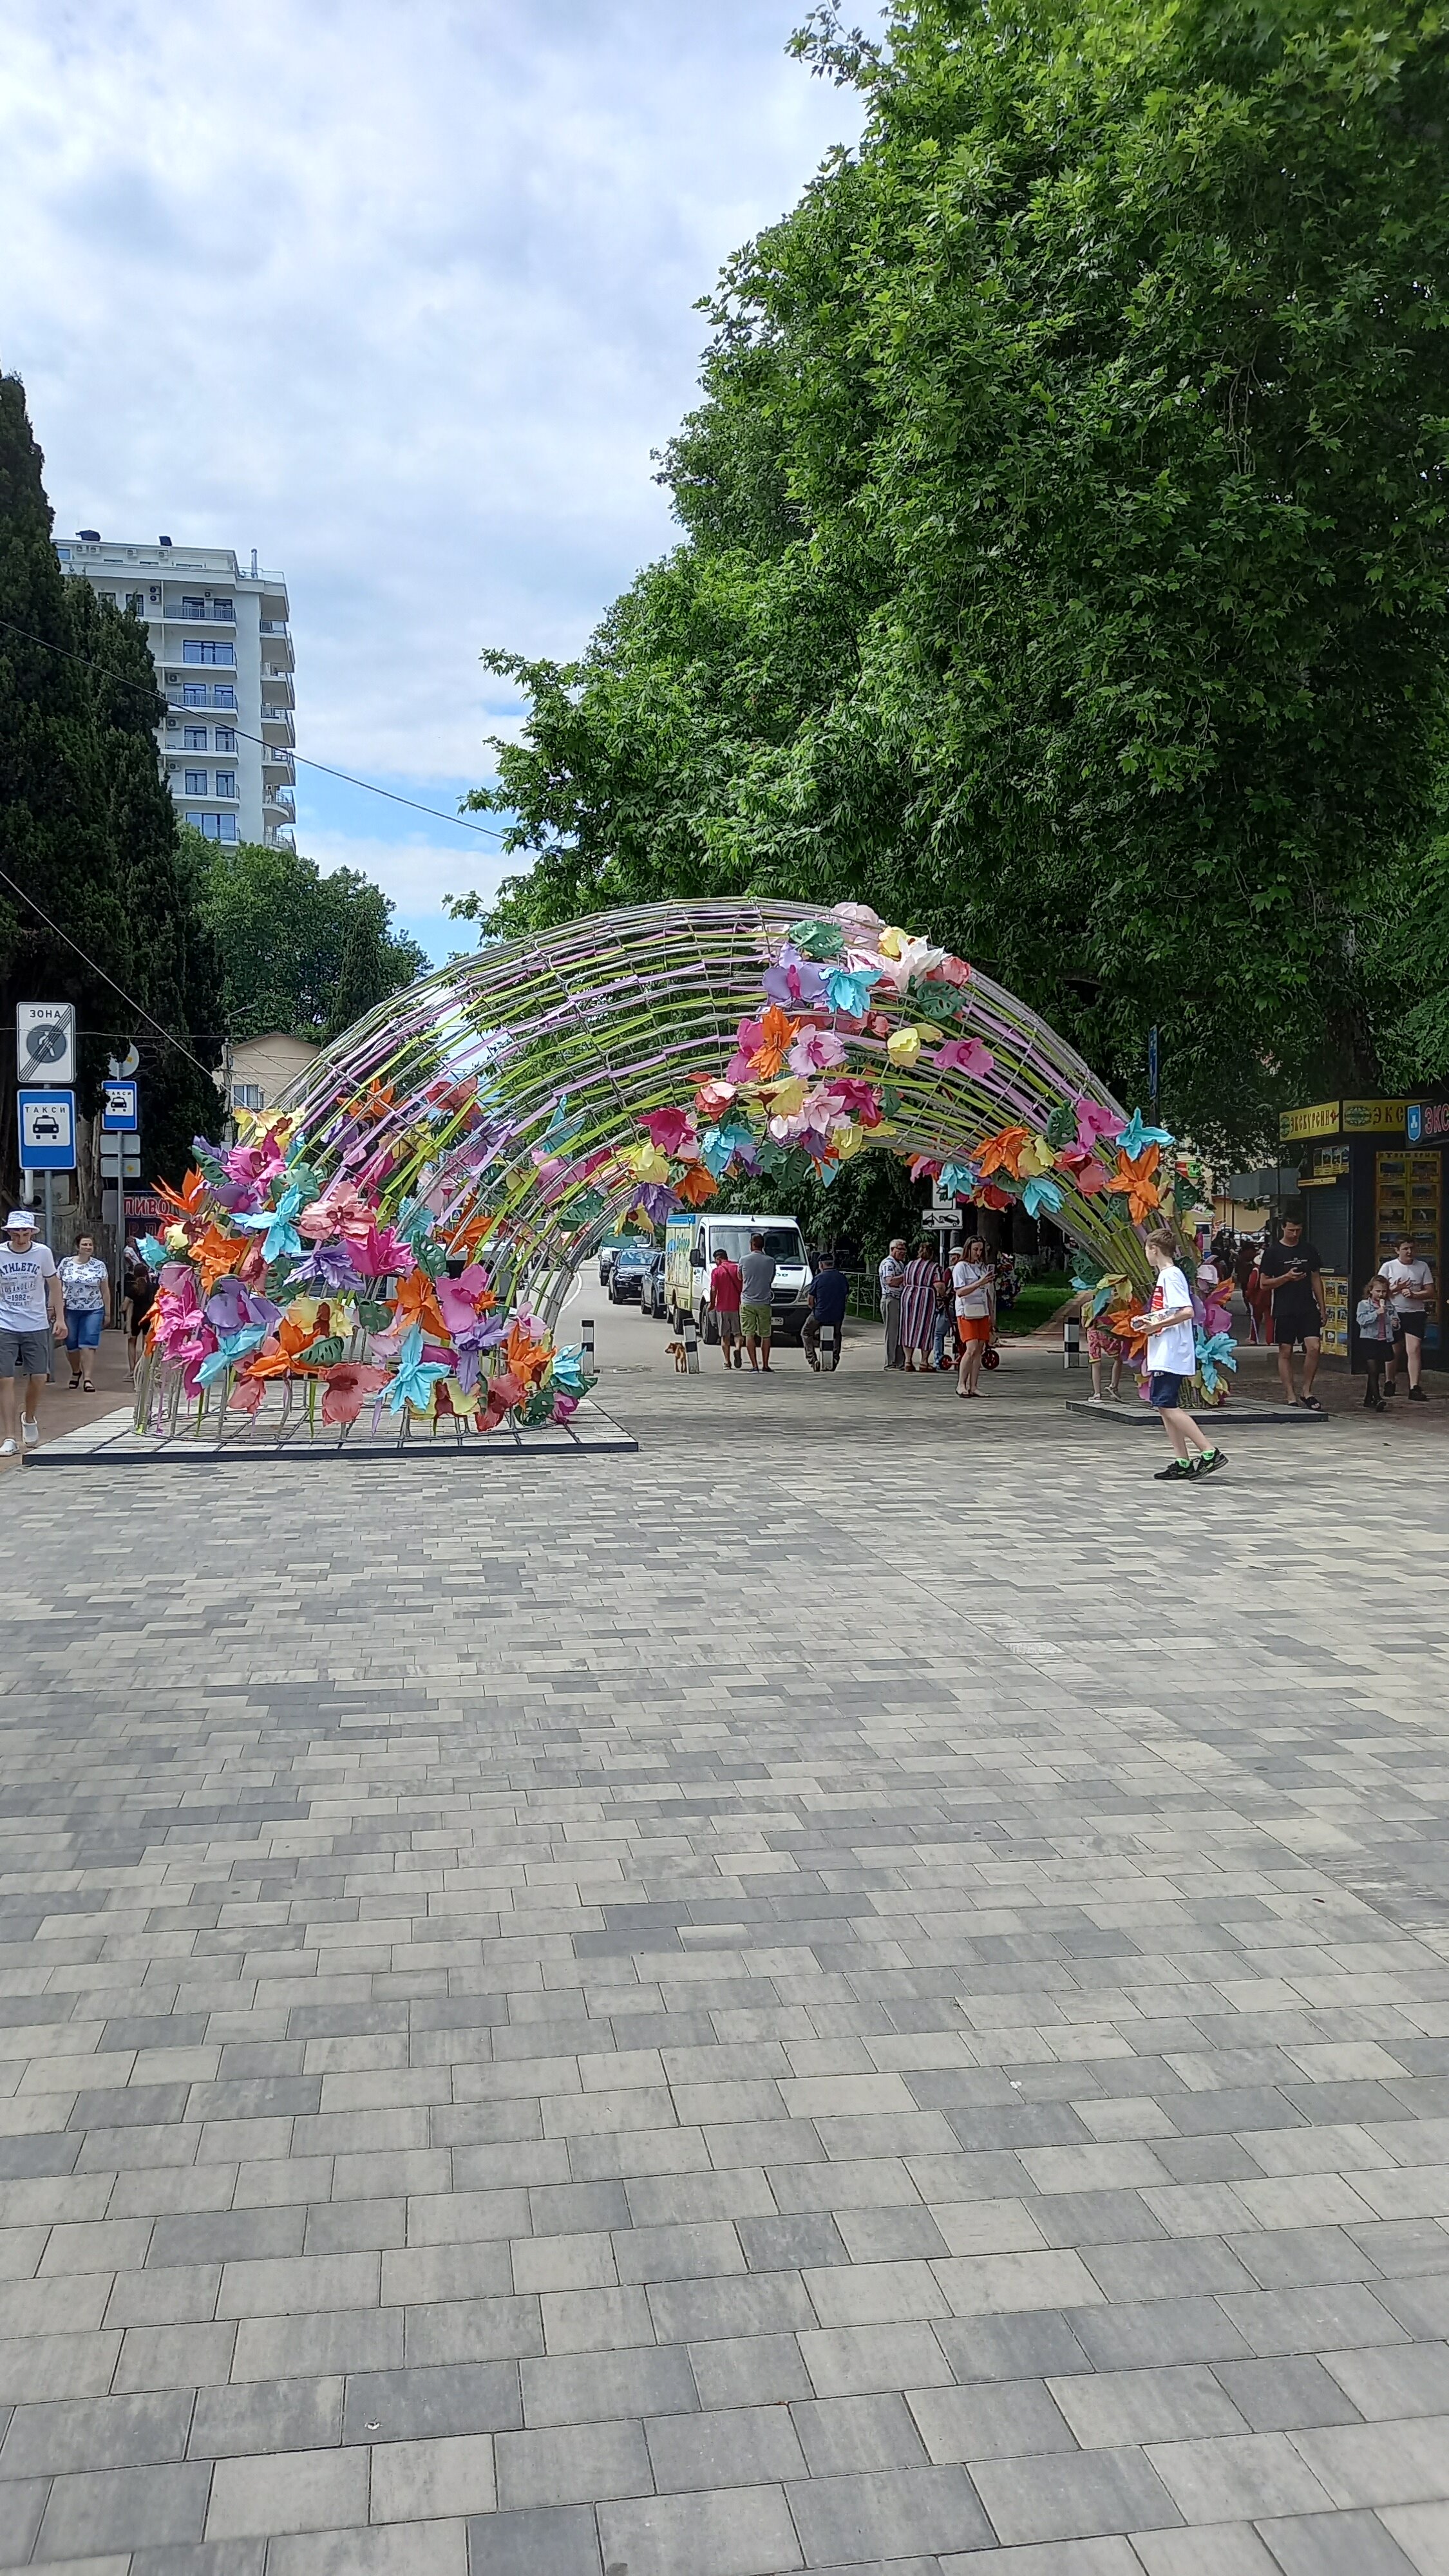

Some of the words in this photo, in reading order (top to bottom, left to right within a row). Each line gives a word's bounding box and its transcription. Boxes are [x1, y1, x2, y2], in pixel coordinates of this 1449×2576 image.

[29, 1009, 62, 1018] ЗОНА
[1290, 1109, 1330, 1133] ЭКСКУРСИИ
[124, 1197, 170, 1217] ПИВО
